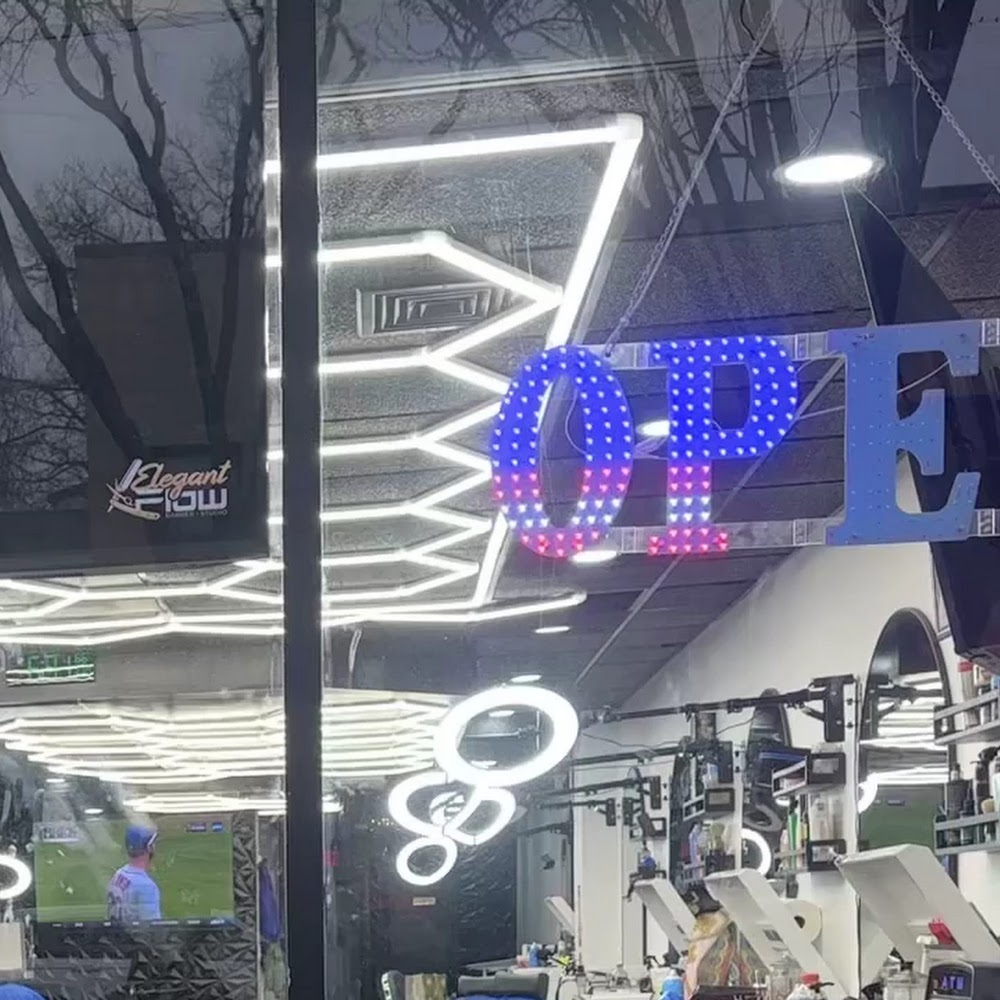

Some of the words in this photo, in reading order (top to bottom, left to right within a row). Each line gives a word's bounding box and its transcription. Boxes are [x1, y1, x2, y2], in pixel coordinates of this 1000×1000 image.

[491, 324, 982, 559] OPE
[131, 459, 232, 500] Elegant
[941, 975, 964, 990] ATM
